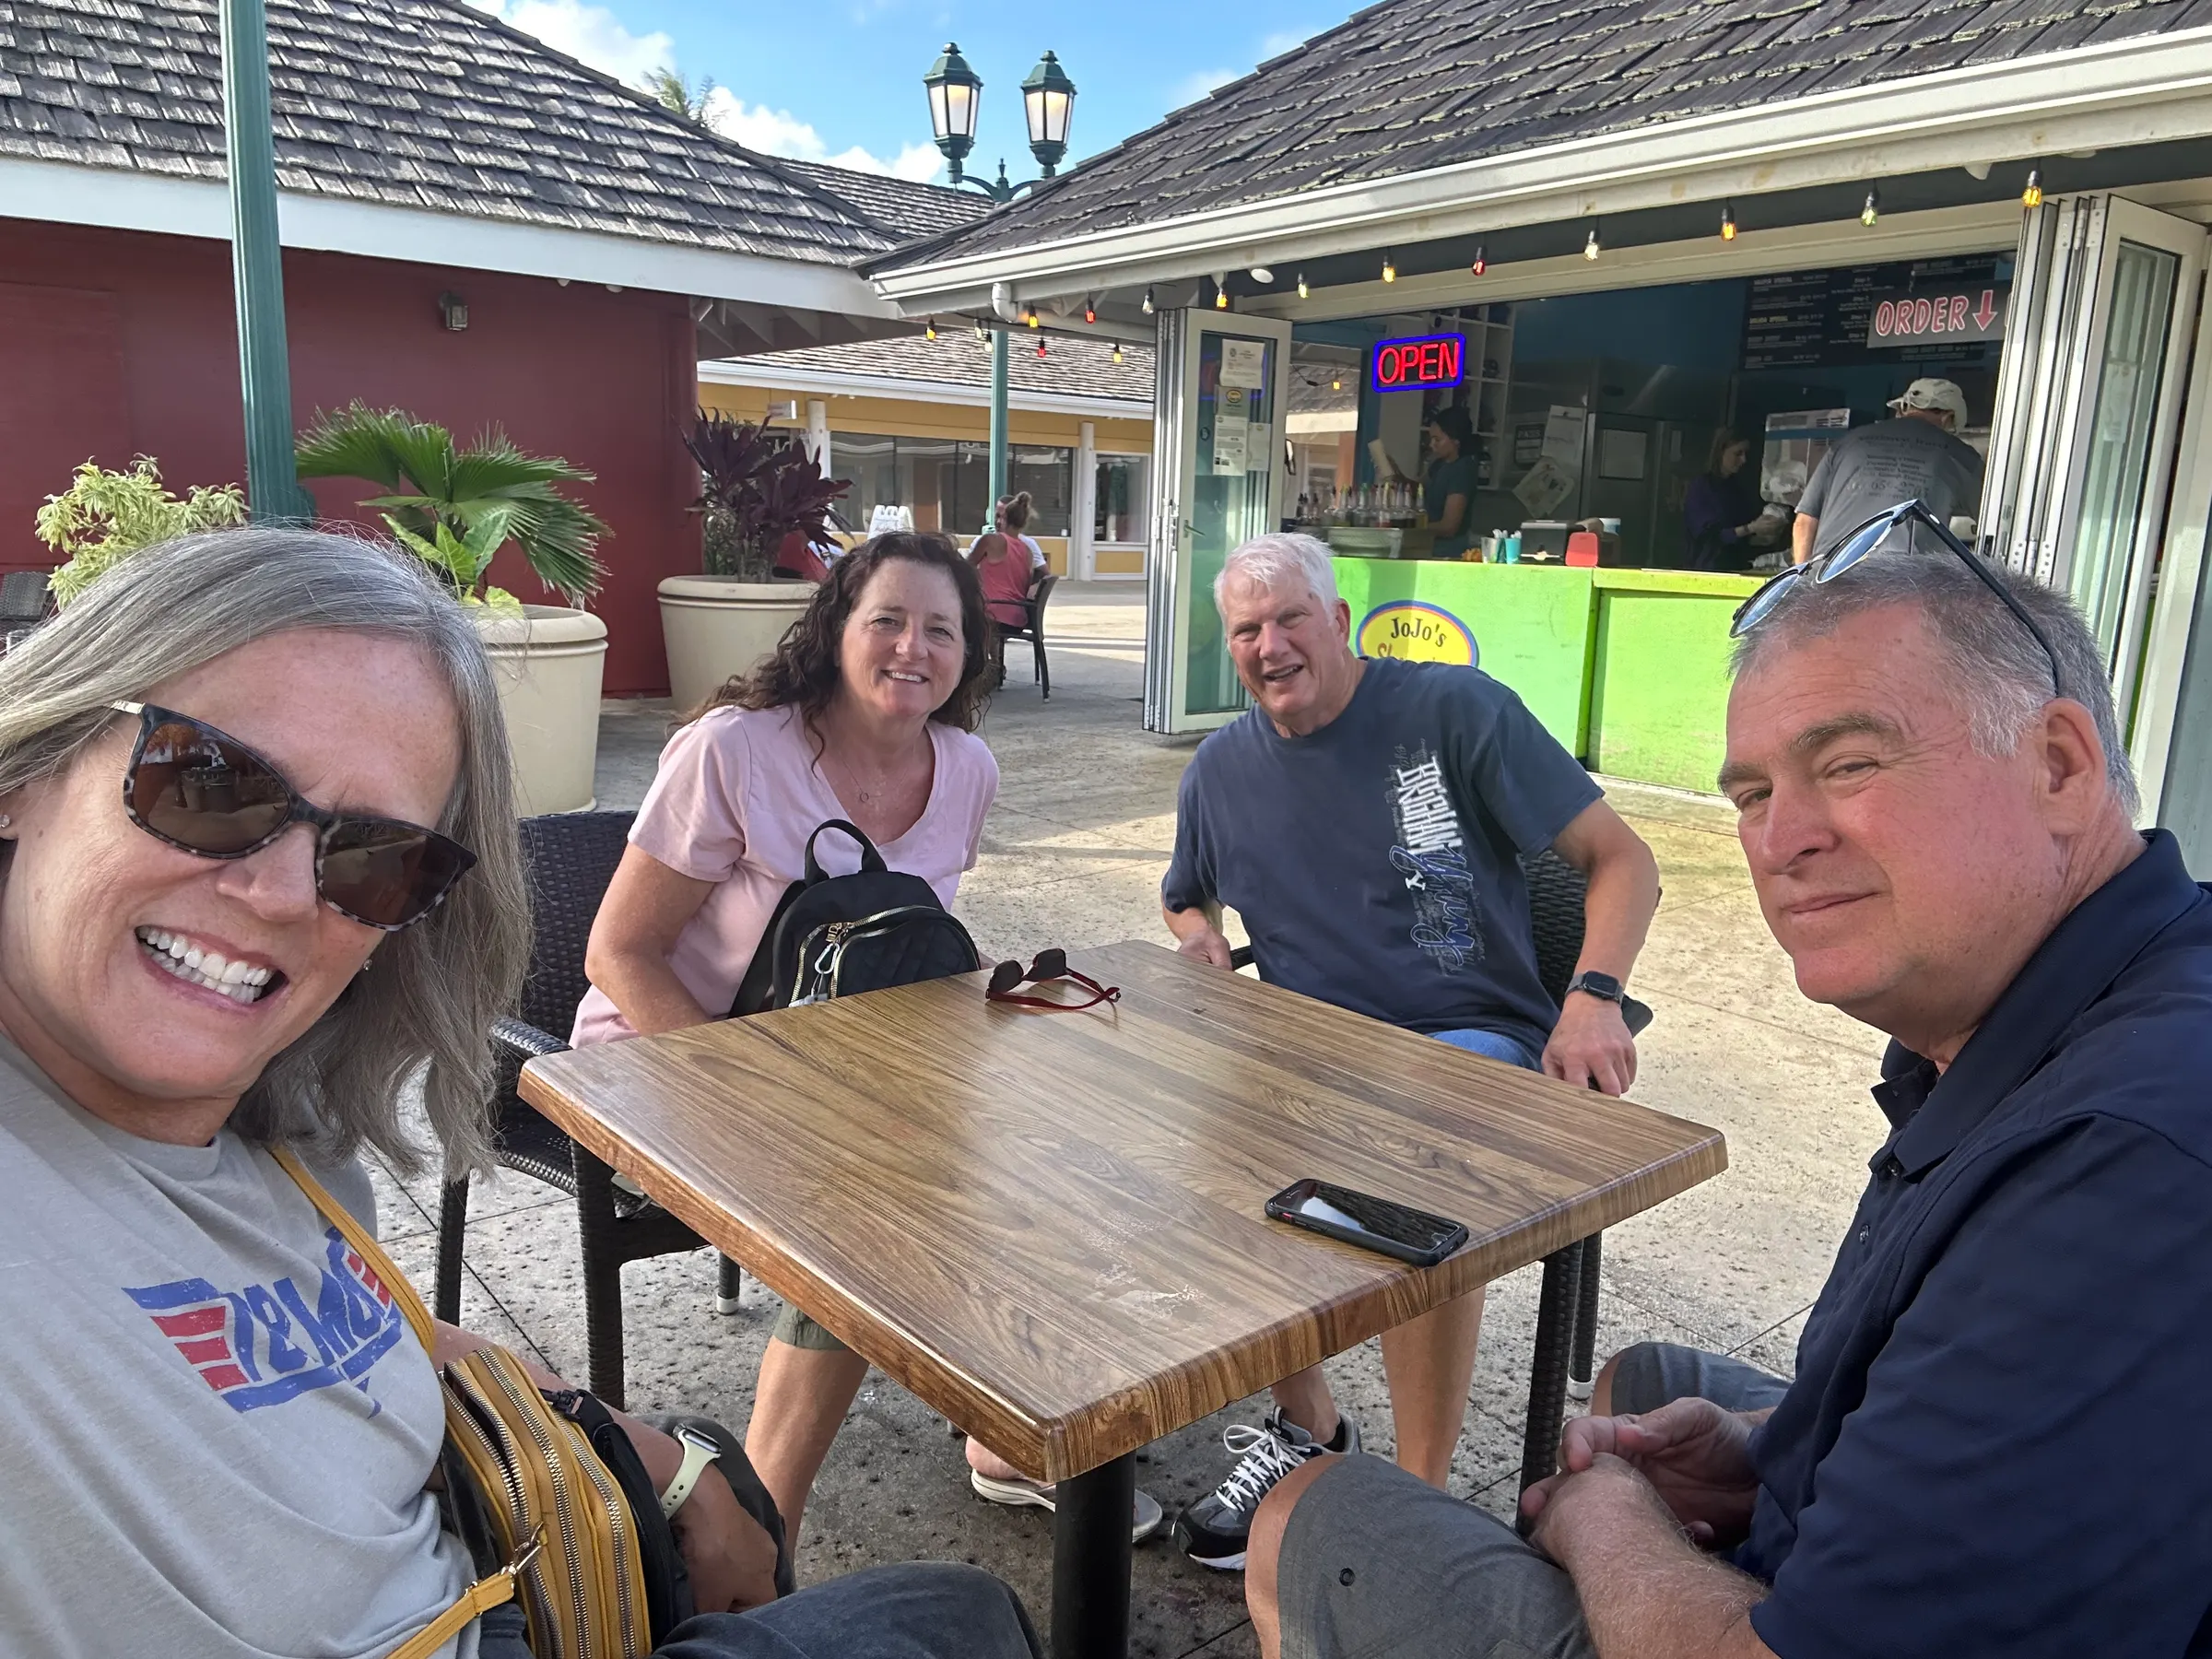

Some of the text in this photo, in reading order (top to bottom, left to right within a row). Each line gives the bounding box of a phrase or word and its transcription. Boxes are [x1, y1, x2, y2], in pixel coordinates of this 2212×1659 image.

[1875, 296, 1970, 336] ORDER
[1378, 342, 1459, 384] OPEN
[1391, 617, 1448, 648] JoJo's
